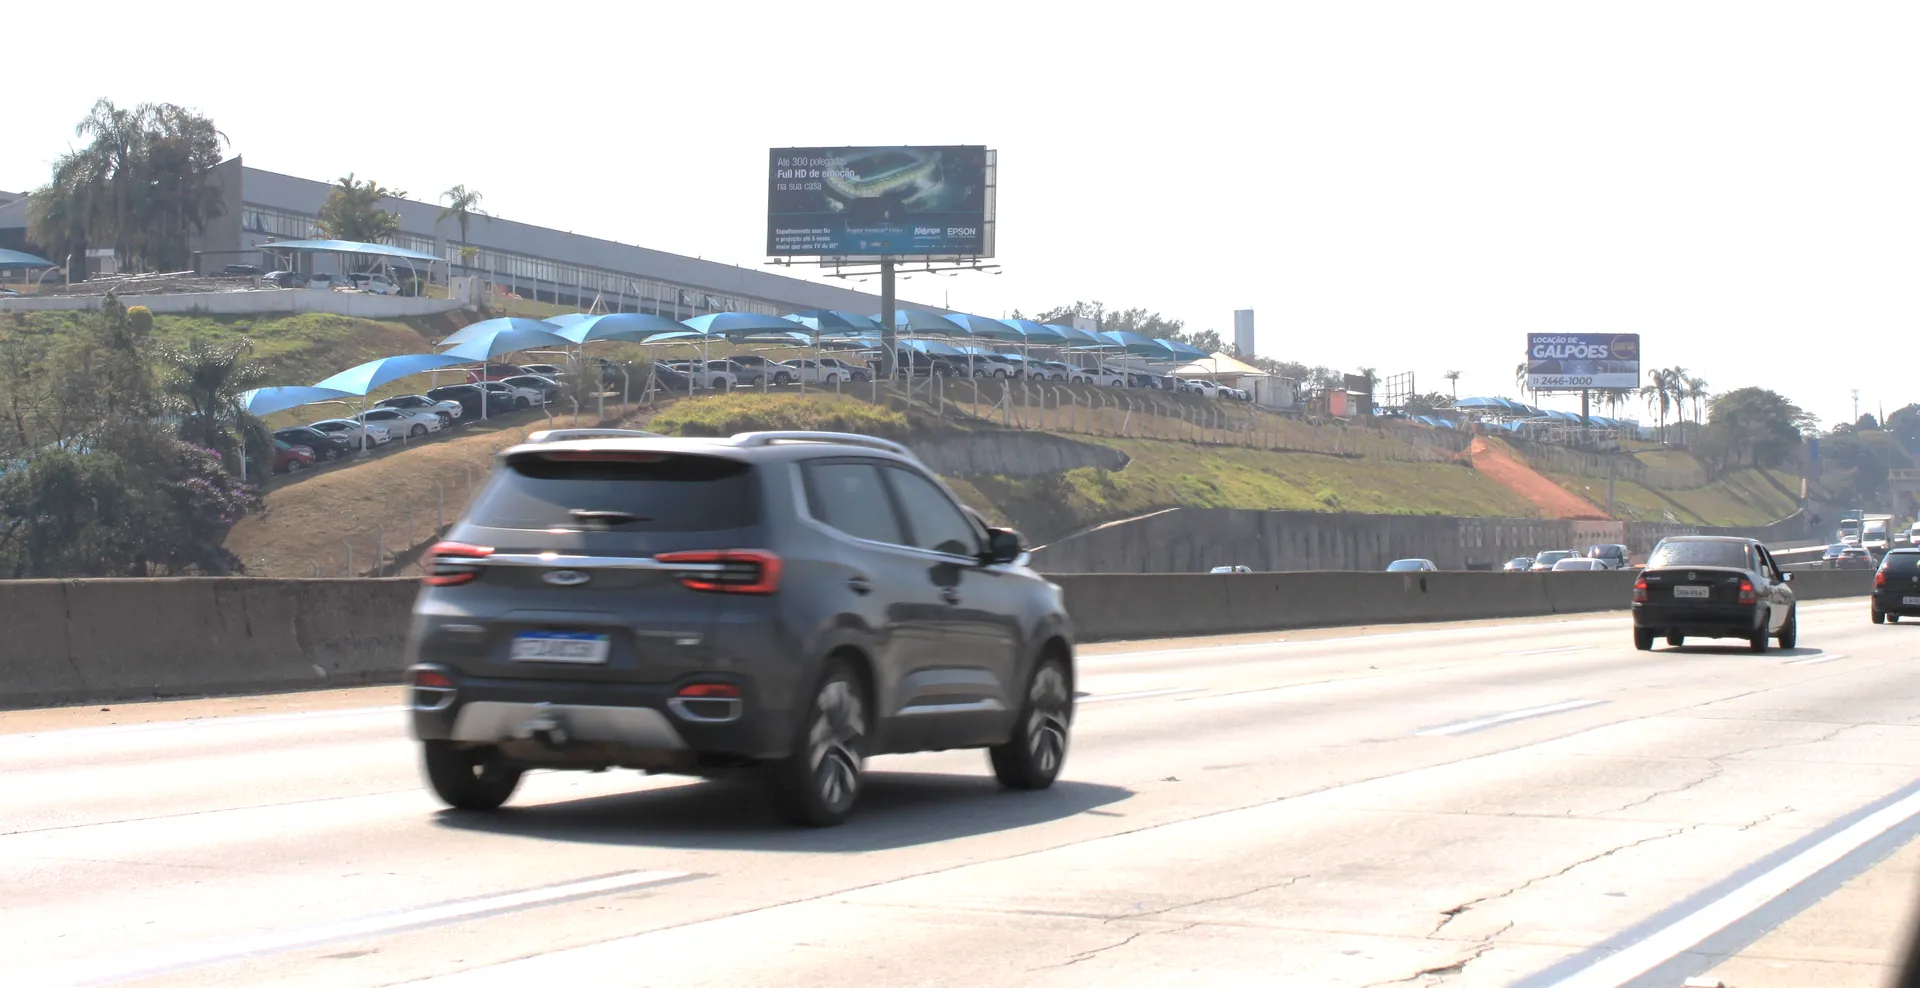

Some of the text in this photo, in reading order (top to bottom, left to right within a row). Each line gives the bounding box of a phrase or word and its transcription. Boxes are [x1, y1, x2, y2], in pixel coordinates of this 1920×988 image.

[777, 157, 790, 167] Até
[792, 157, 808, 166] 300
[777, 168, 855, 179] Full HD de emoção
[804, 182, 822, 190] casa
[947, 227, 976, 235] EPSON
[1532, 336, 1566, 344] LOCAÇÃO
[1532, 341, 1608, 359] GALPÕES
[1541, 376, 1593, 385] 2446-1000
